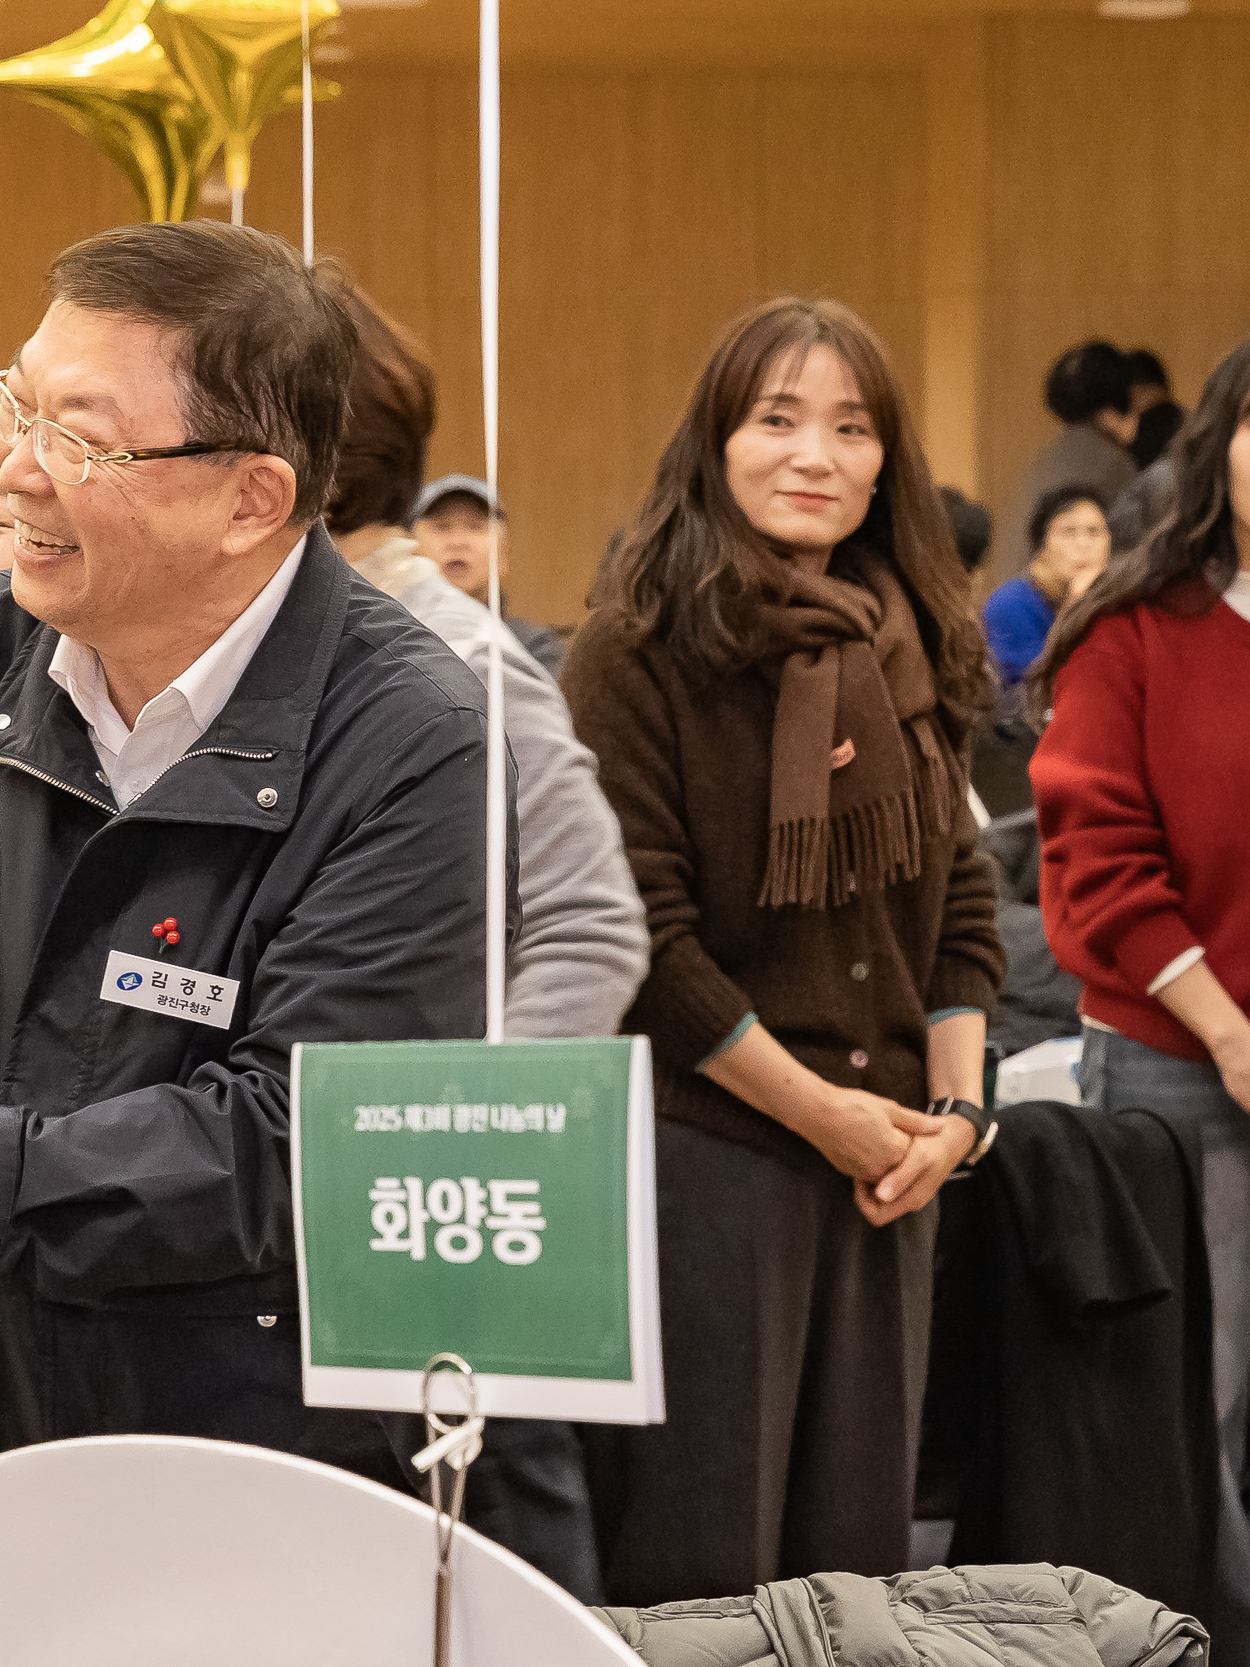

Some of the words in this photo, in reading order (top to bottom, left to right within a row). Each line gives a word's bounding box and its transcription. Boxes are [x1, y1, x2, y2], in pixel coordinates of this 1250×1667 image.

[157, 994, 211, 1016] 광진구청장
[354, 1105, 403, 1131] 2025
[369, 1176, 547, 1266] 화양동
